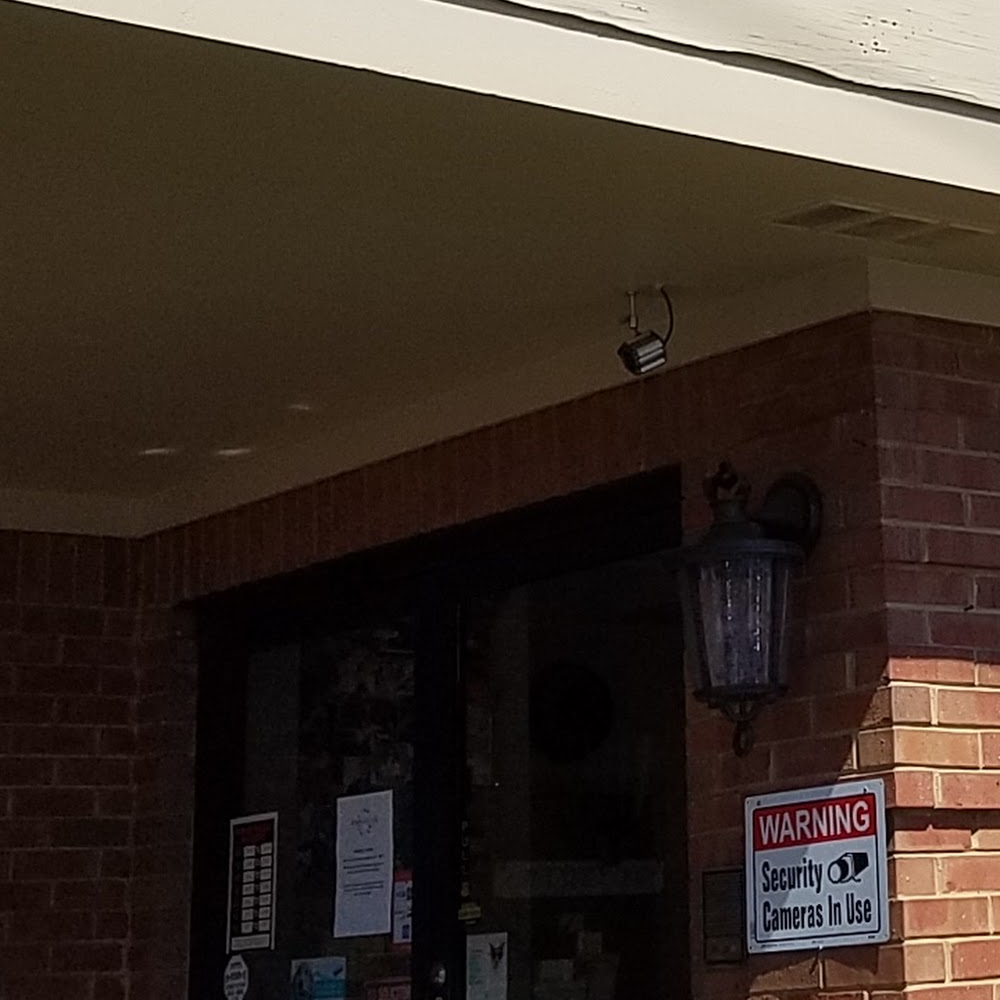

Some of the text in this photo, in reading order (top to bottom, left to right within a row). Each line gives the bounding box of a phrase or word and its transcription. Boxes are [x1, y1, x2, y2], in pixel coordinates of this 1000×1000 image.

[759, 800, 870, 845] WARNING
[762, 857, 823, 893] Security
[763, 893, 872, 932] Cameras In Use
